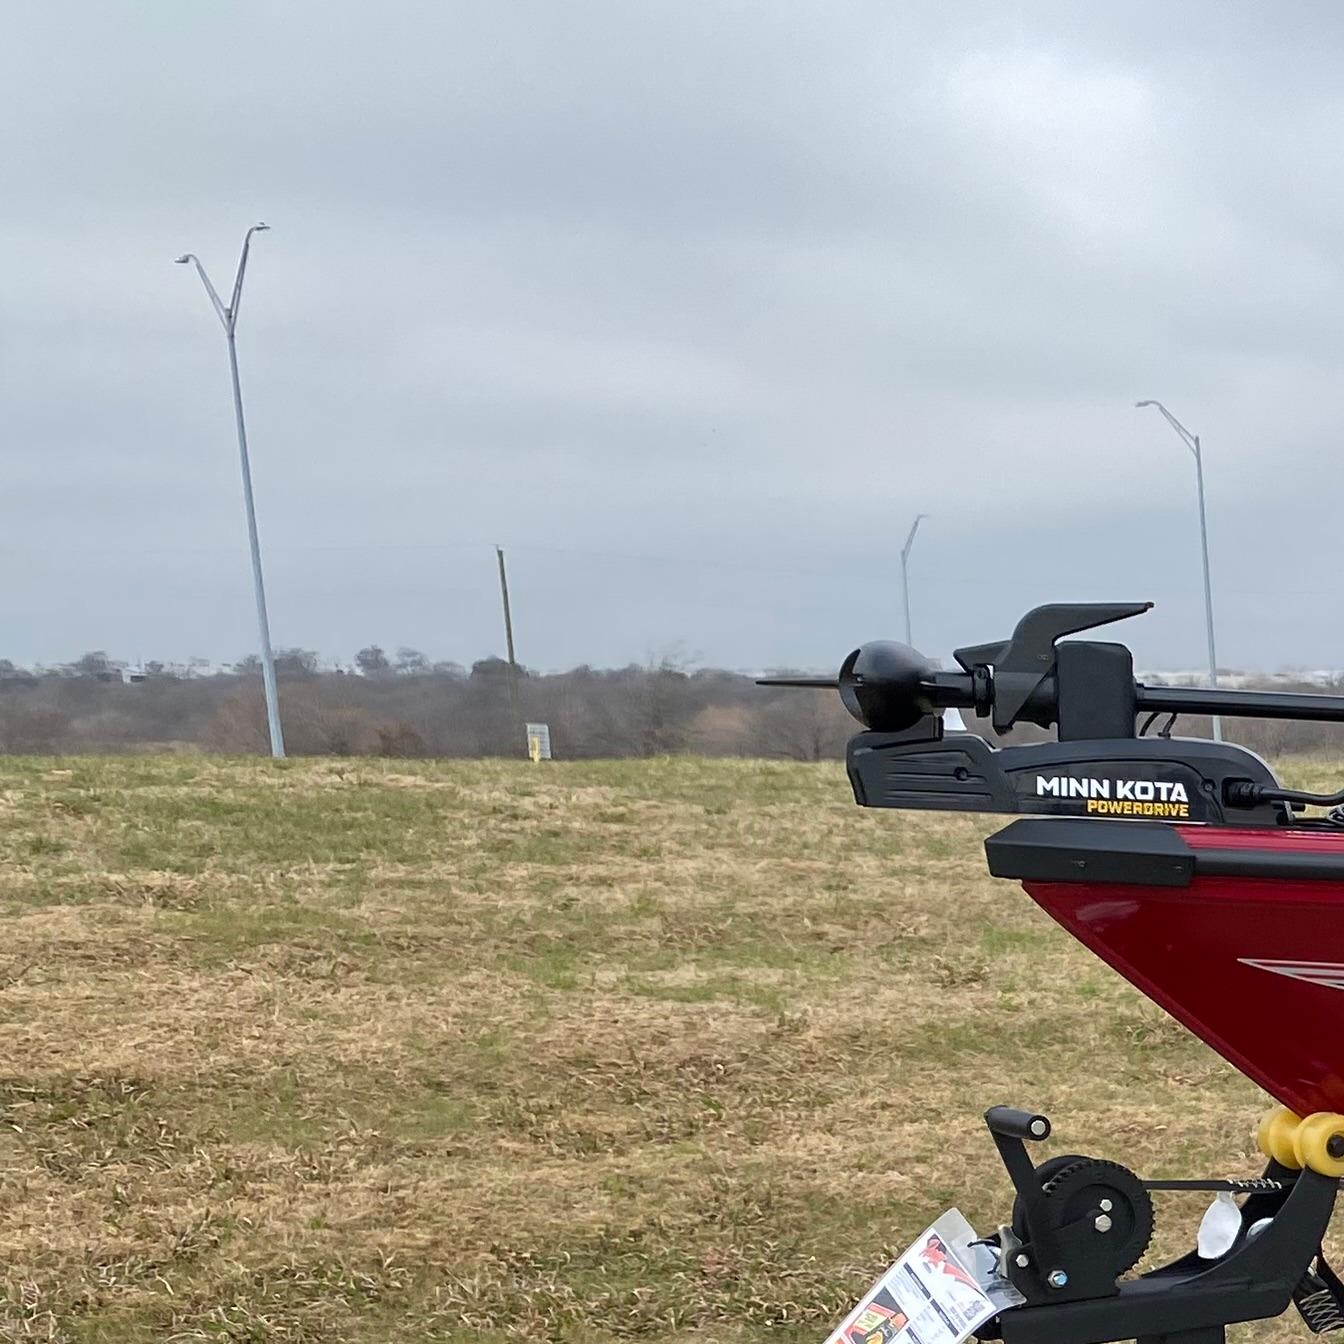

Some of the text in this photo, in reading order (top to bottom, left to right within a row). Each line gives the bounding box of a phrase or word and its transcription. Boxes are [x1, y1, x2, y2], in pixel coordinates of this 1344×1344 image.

[1036, 775, 1189, 802] MINN KOTA
[1087, 799, 1190, 817] POWERDRIVE
